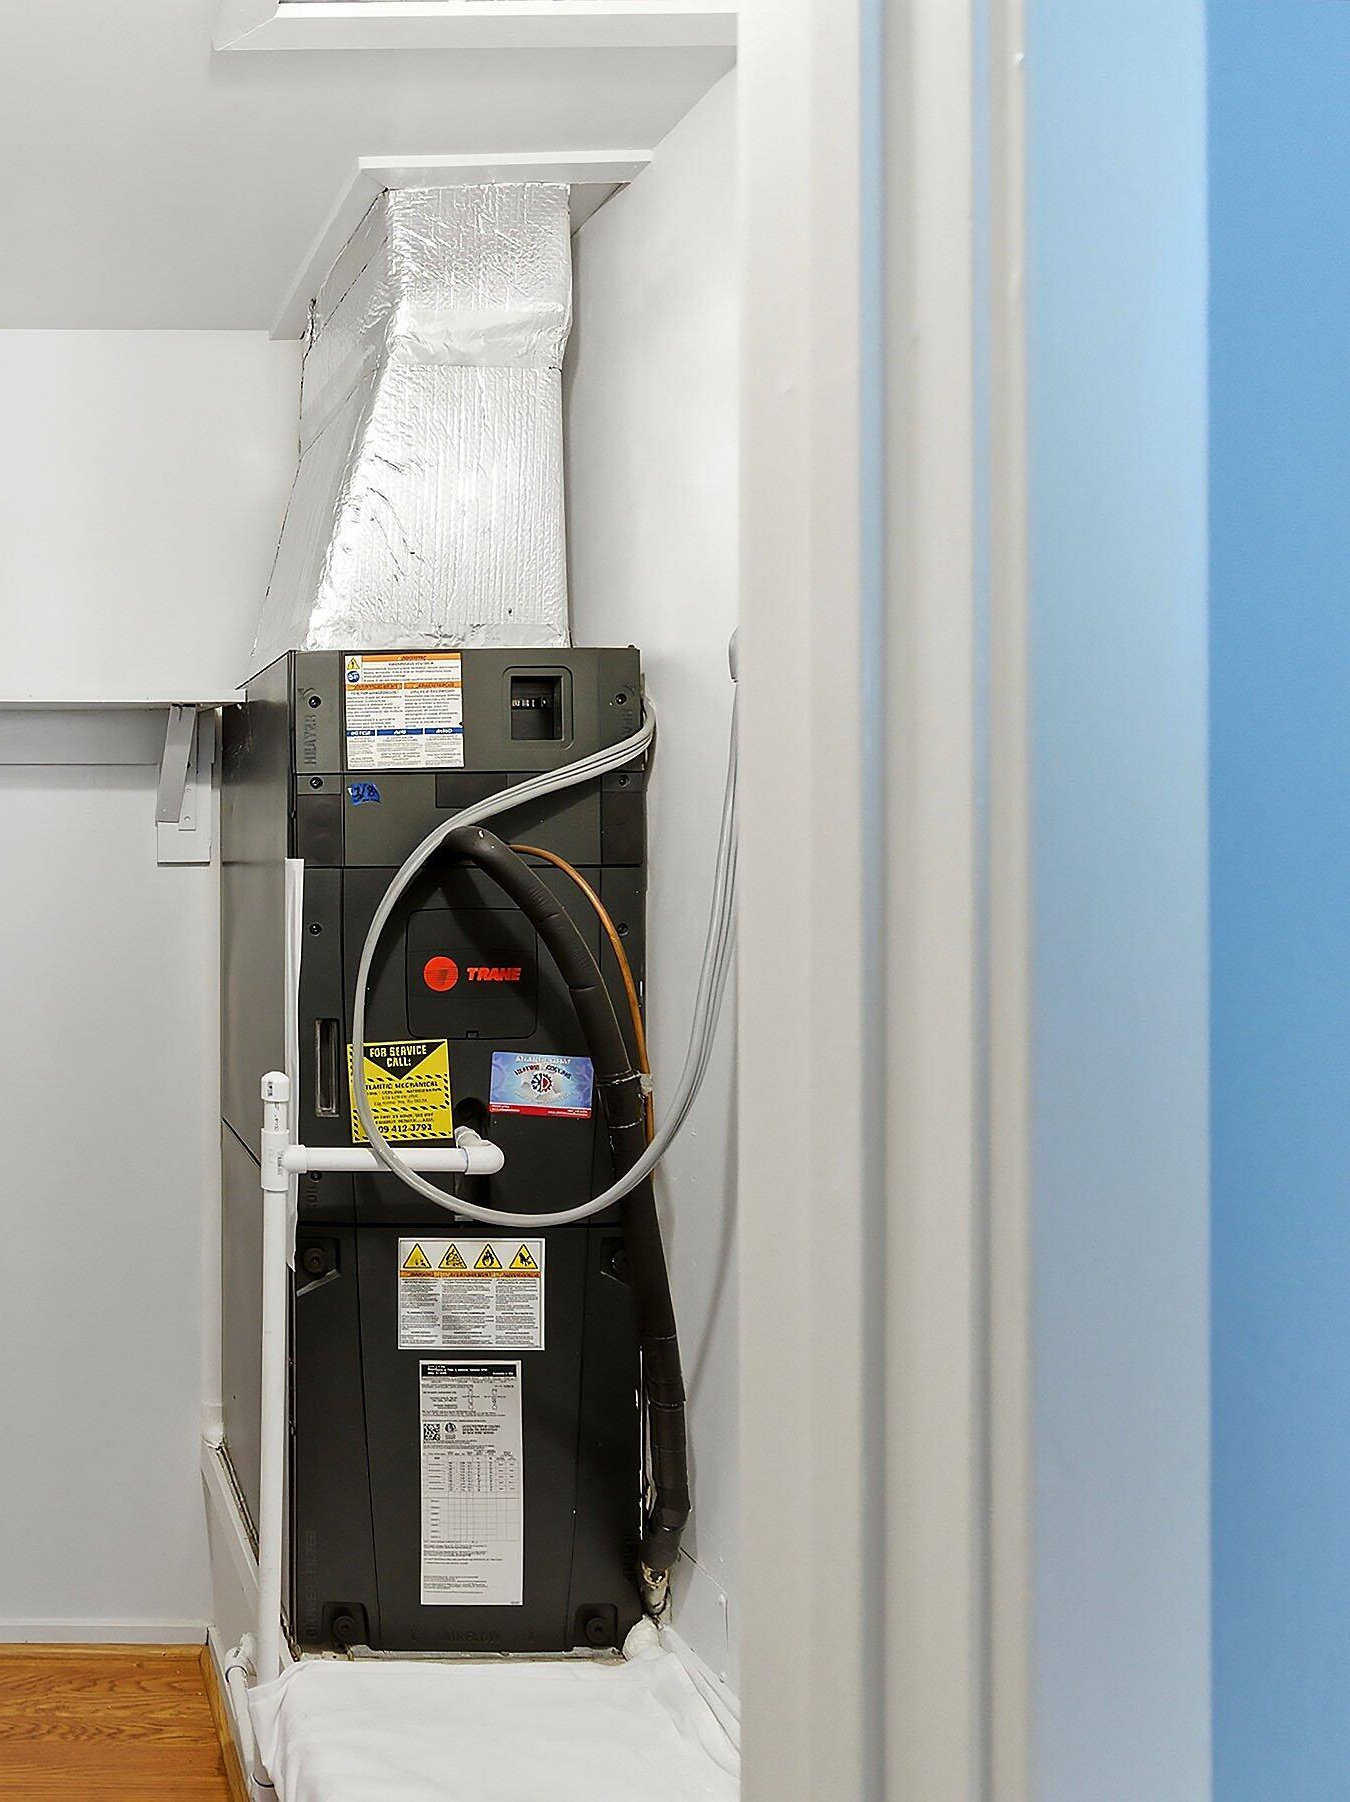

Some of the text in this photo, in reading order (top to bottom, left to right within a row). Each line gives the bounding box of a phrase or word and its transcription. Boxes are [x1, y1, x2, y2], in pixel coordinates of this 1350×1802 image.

[466, 967, 522, 981] TRANE
[369, 1044, 427, 1058] FOR SERVICE
[386, 1057, 412, 1068] CALL:
